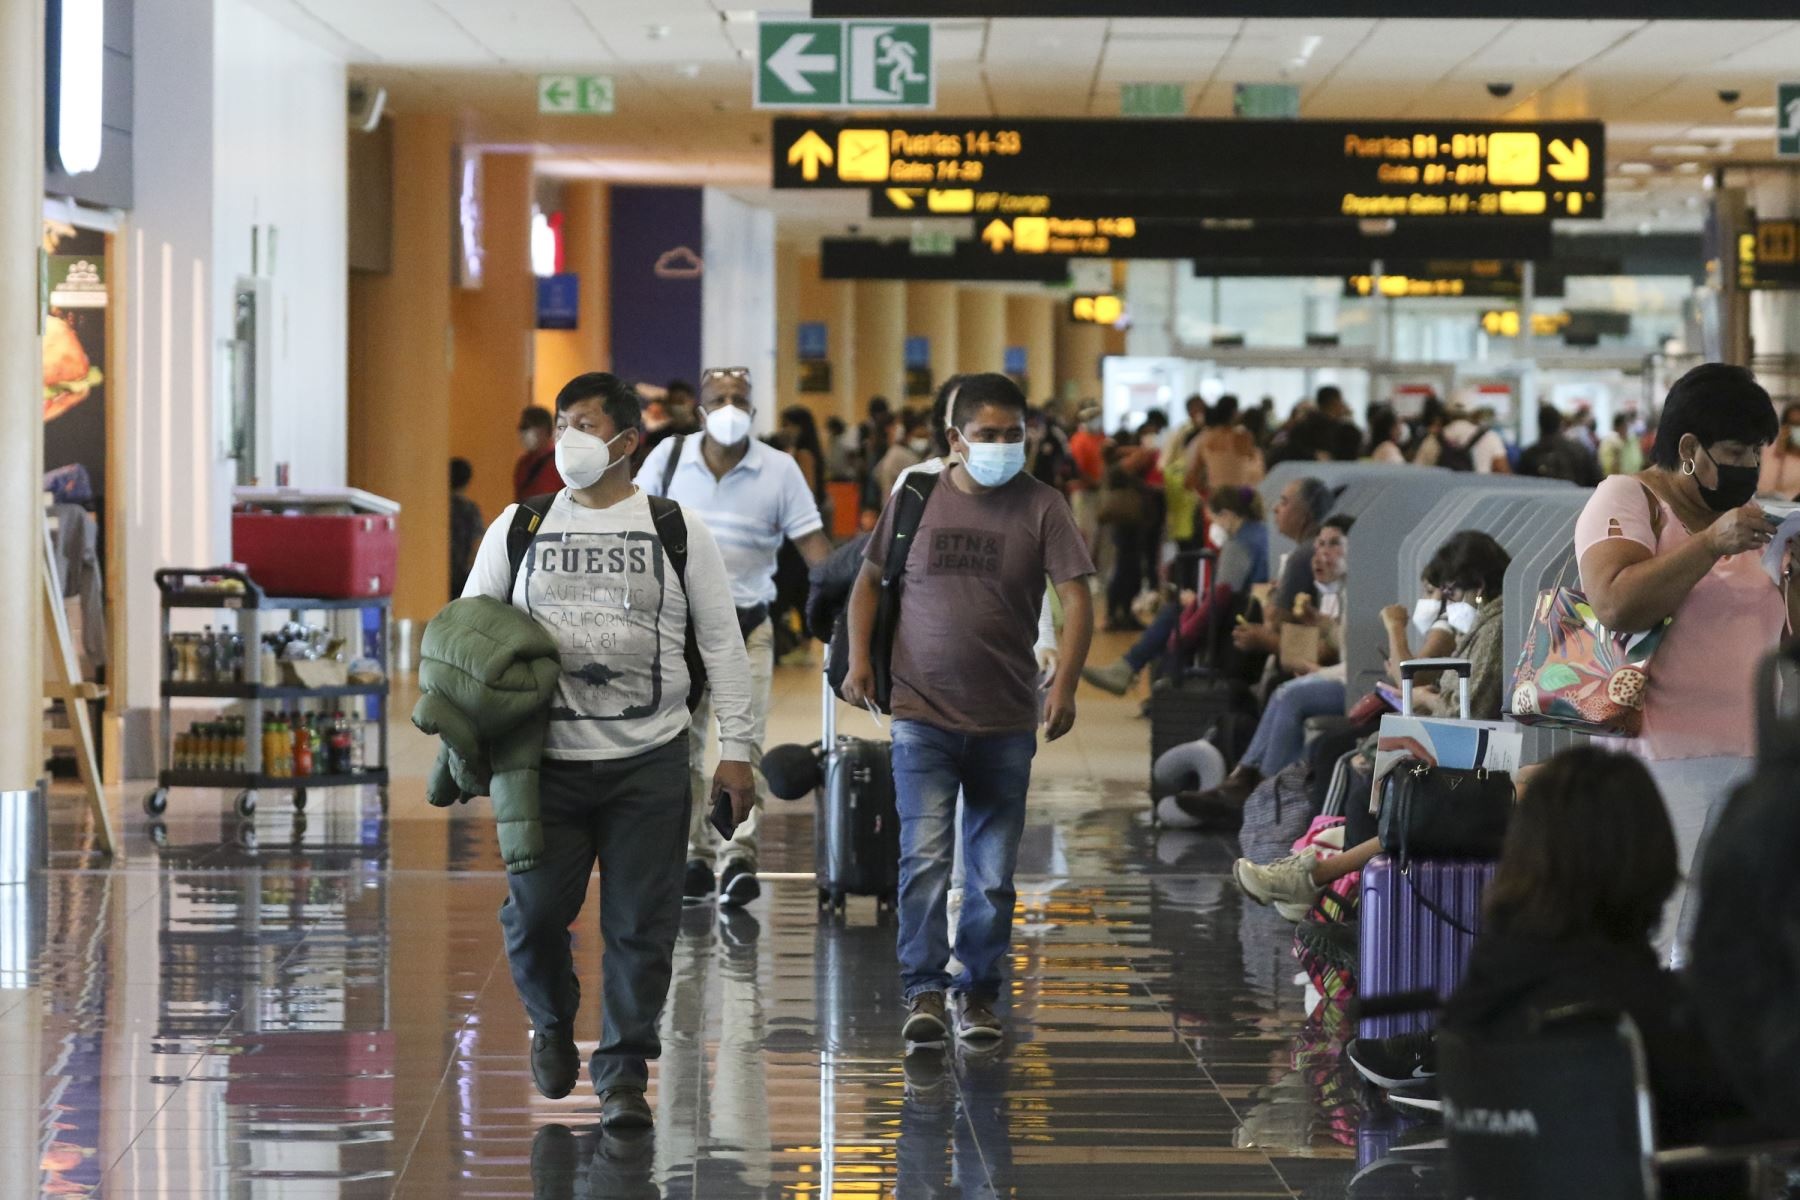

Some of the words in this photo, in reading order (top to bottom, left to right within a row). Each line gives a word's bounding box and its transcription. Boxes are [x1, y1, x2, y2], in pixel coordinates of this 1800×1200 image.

[891, 129, 961, 157] Puertas
[965, 130, 1021, 156] 14-33
[1344, 133, 1411, 158] Puertas
[890, 159, 935, 182] Gates
[932, 553, 998, 573] JEANS
[542, 584, 646, 606] AUTHENTIC
[572, 632, 595, 649] LA
[600, 632, 617, 649] 81
